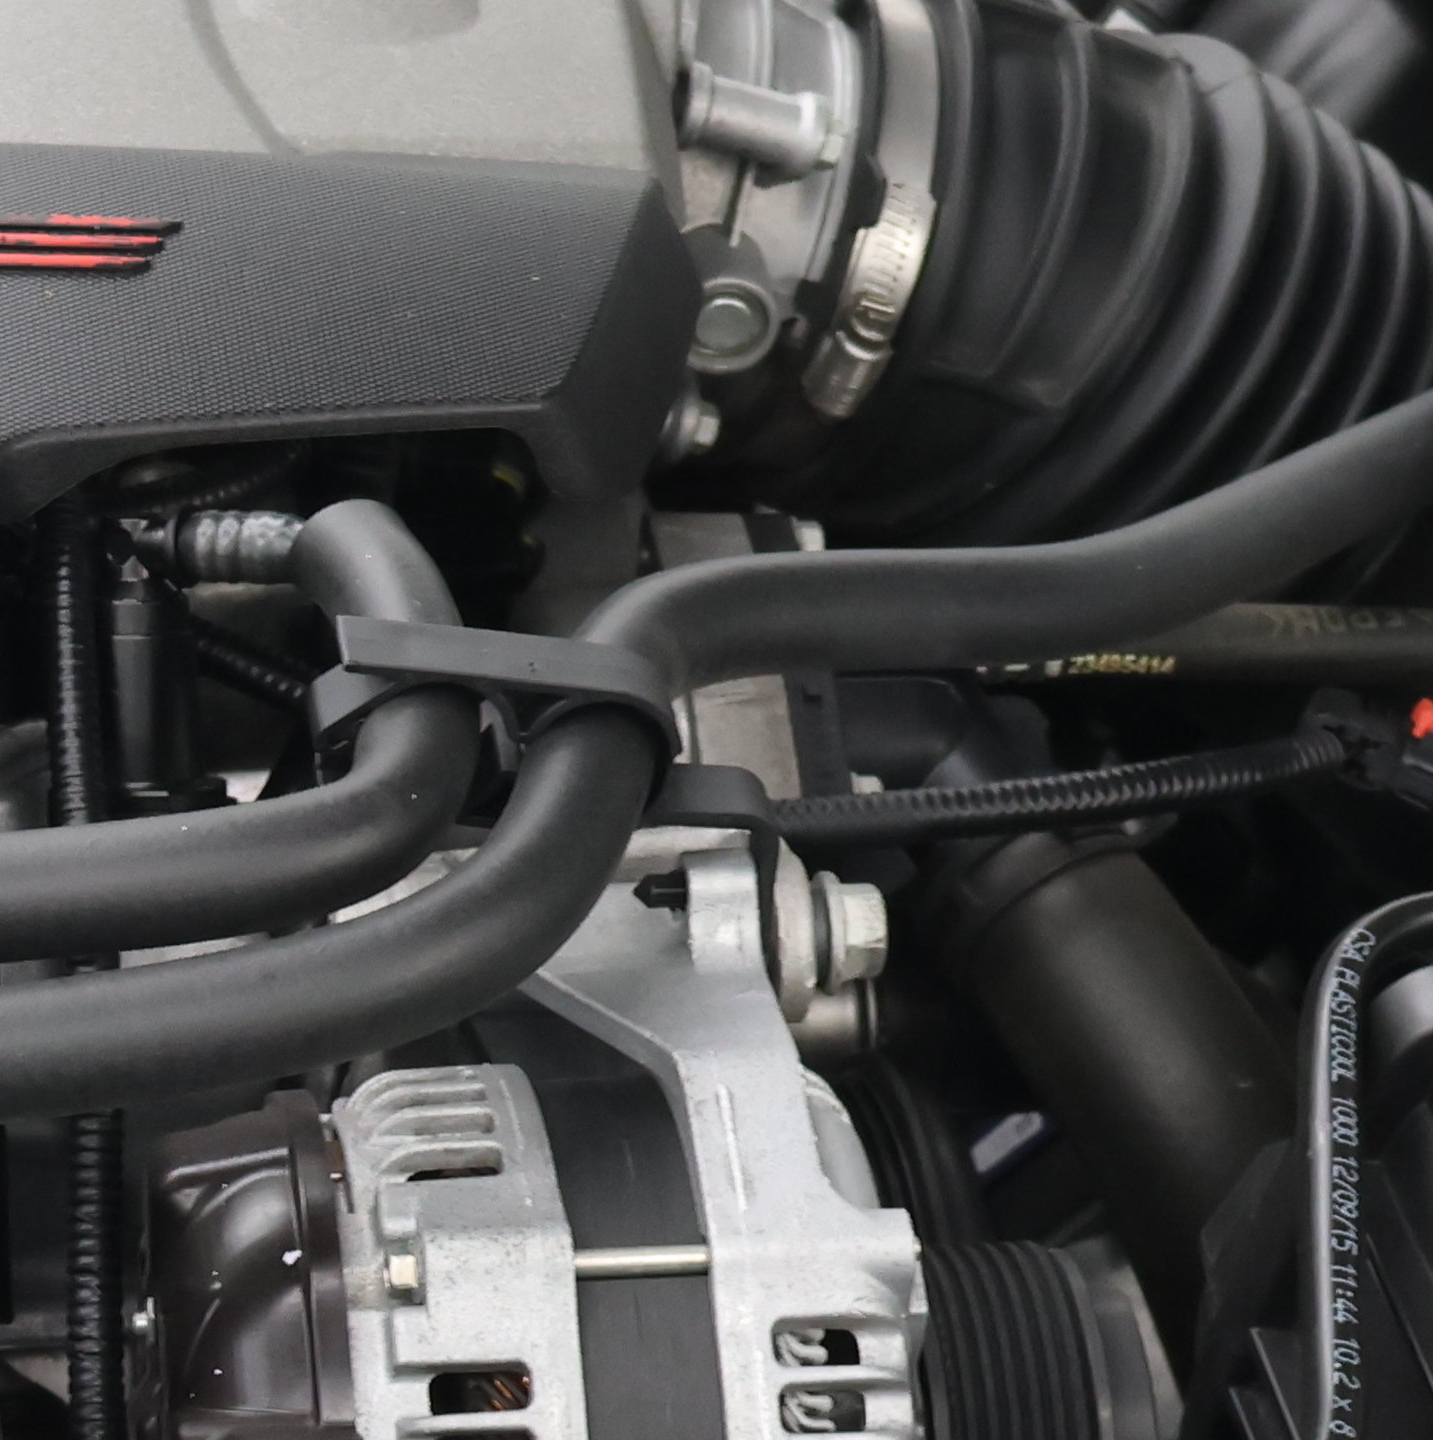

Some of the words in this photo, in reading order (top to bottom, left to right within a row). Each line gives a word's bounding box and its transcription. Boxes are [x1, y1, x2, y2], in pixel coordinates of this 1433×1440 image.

[1340, 928, 1376, 962] CSA
[1330, 966, 1361, 1083] PLASTICOOL
[1332, 1096, 1360, 1147] 1000
[1331, 1156, 1360, 1256] 12/09/15
[1331, 1263, 1360, 1325] 11:44
[1332, 1338, 1362, 1390] 10.2
[1331, 1395, 1353, 1412] x
[1329, 1419, 1357, 1440] 8
